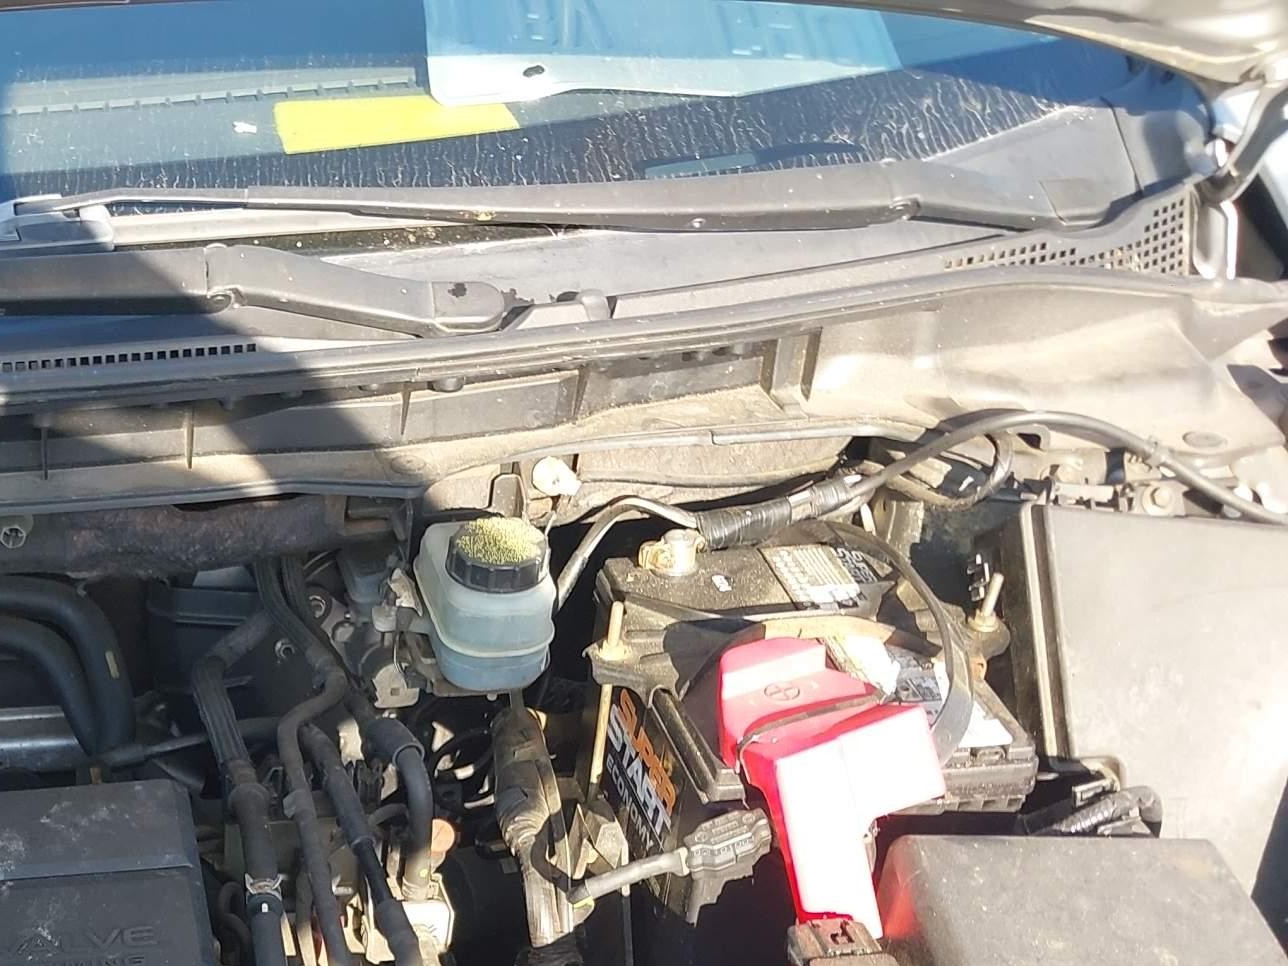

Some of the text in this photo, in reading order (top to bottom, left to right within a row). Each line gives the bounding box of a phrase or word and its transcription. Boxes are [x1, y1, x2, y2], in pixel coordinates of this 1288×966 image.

[606, 753, 654, 851] ECONOMY
[608, 703, 672, 836] START
[620, 687, 676, 817] SUPER
